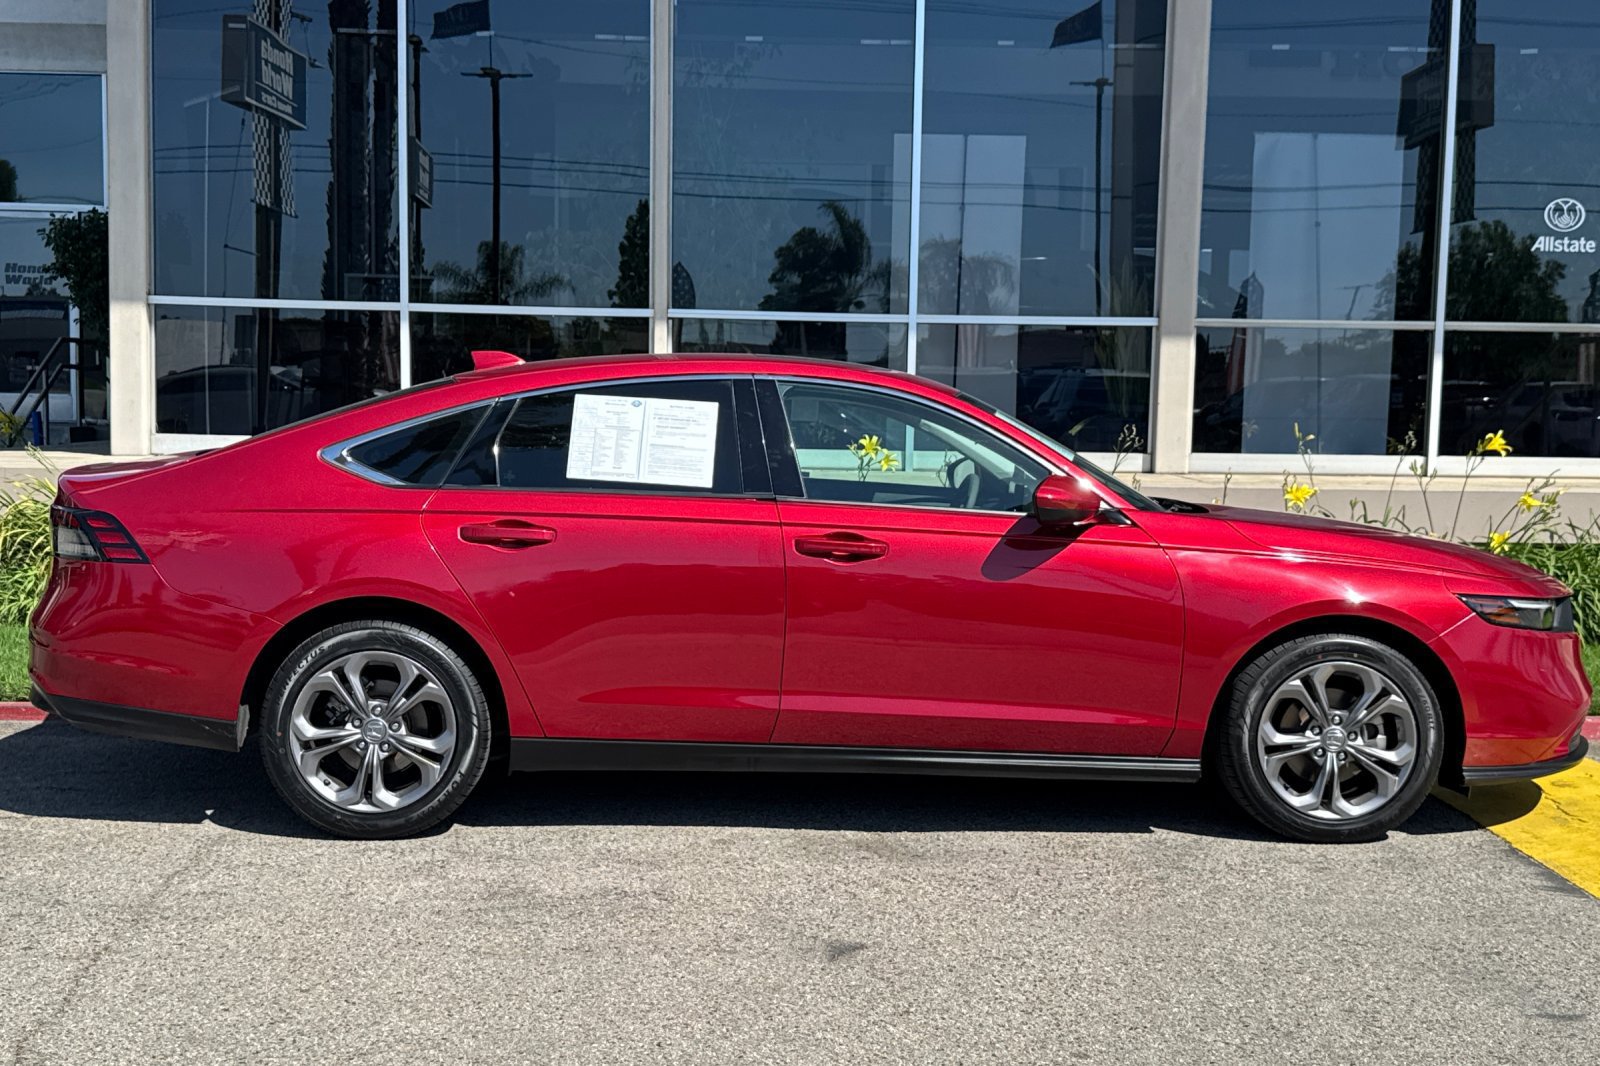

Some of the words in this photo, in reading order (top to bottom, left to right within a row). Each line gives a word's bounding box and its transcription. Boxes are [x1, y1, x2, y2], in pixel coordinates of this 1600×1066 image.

[1530, 236, 1596, 253] Allstate
[4, 263, 48, 274] Hond
[5, 274, 53, 286] World
